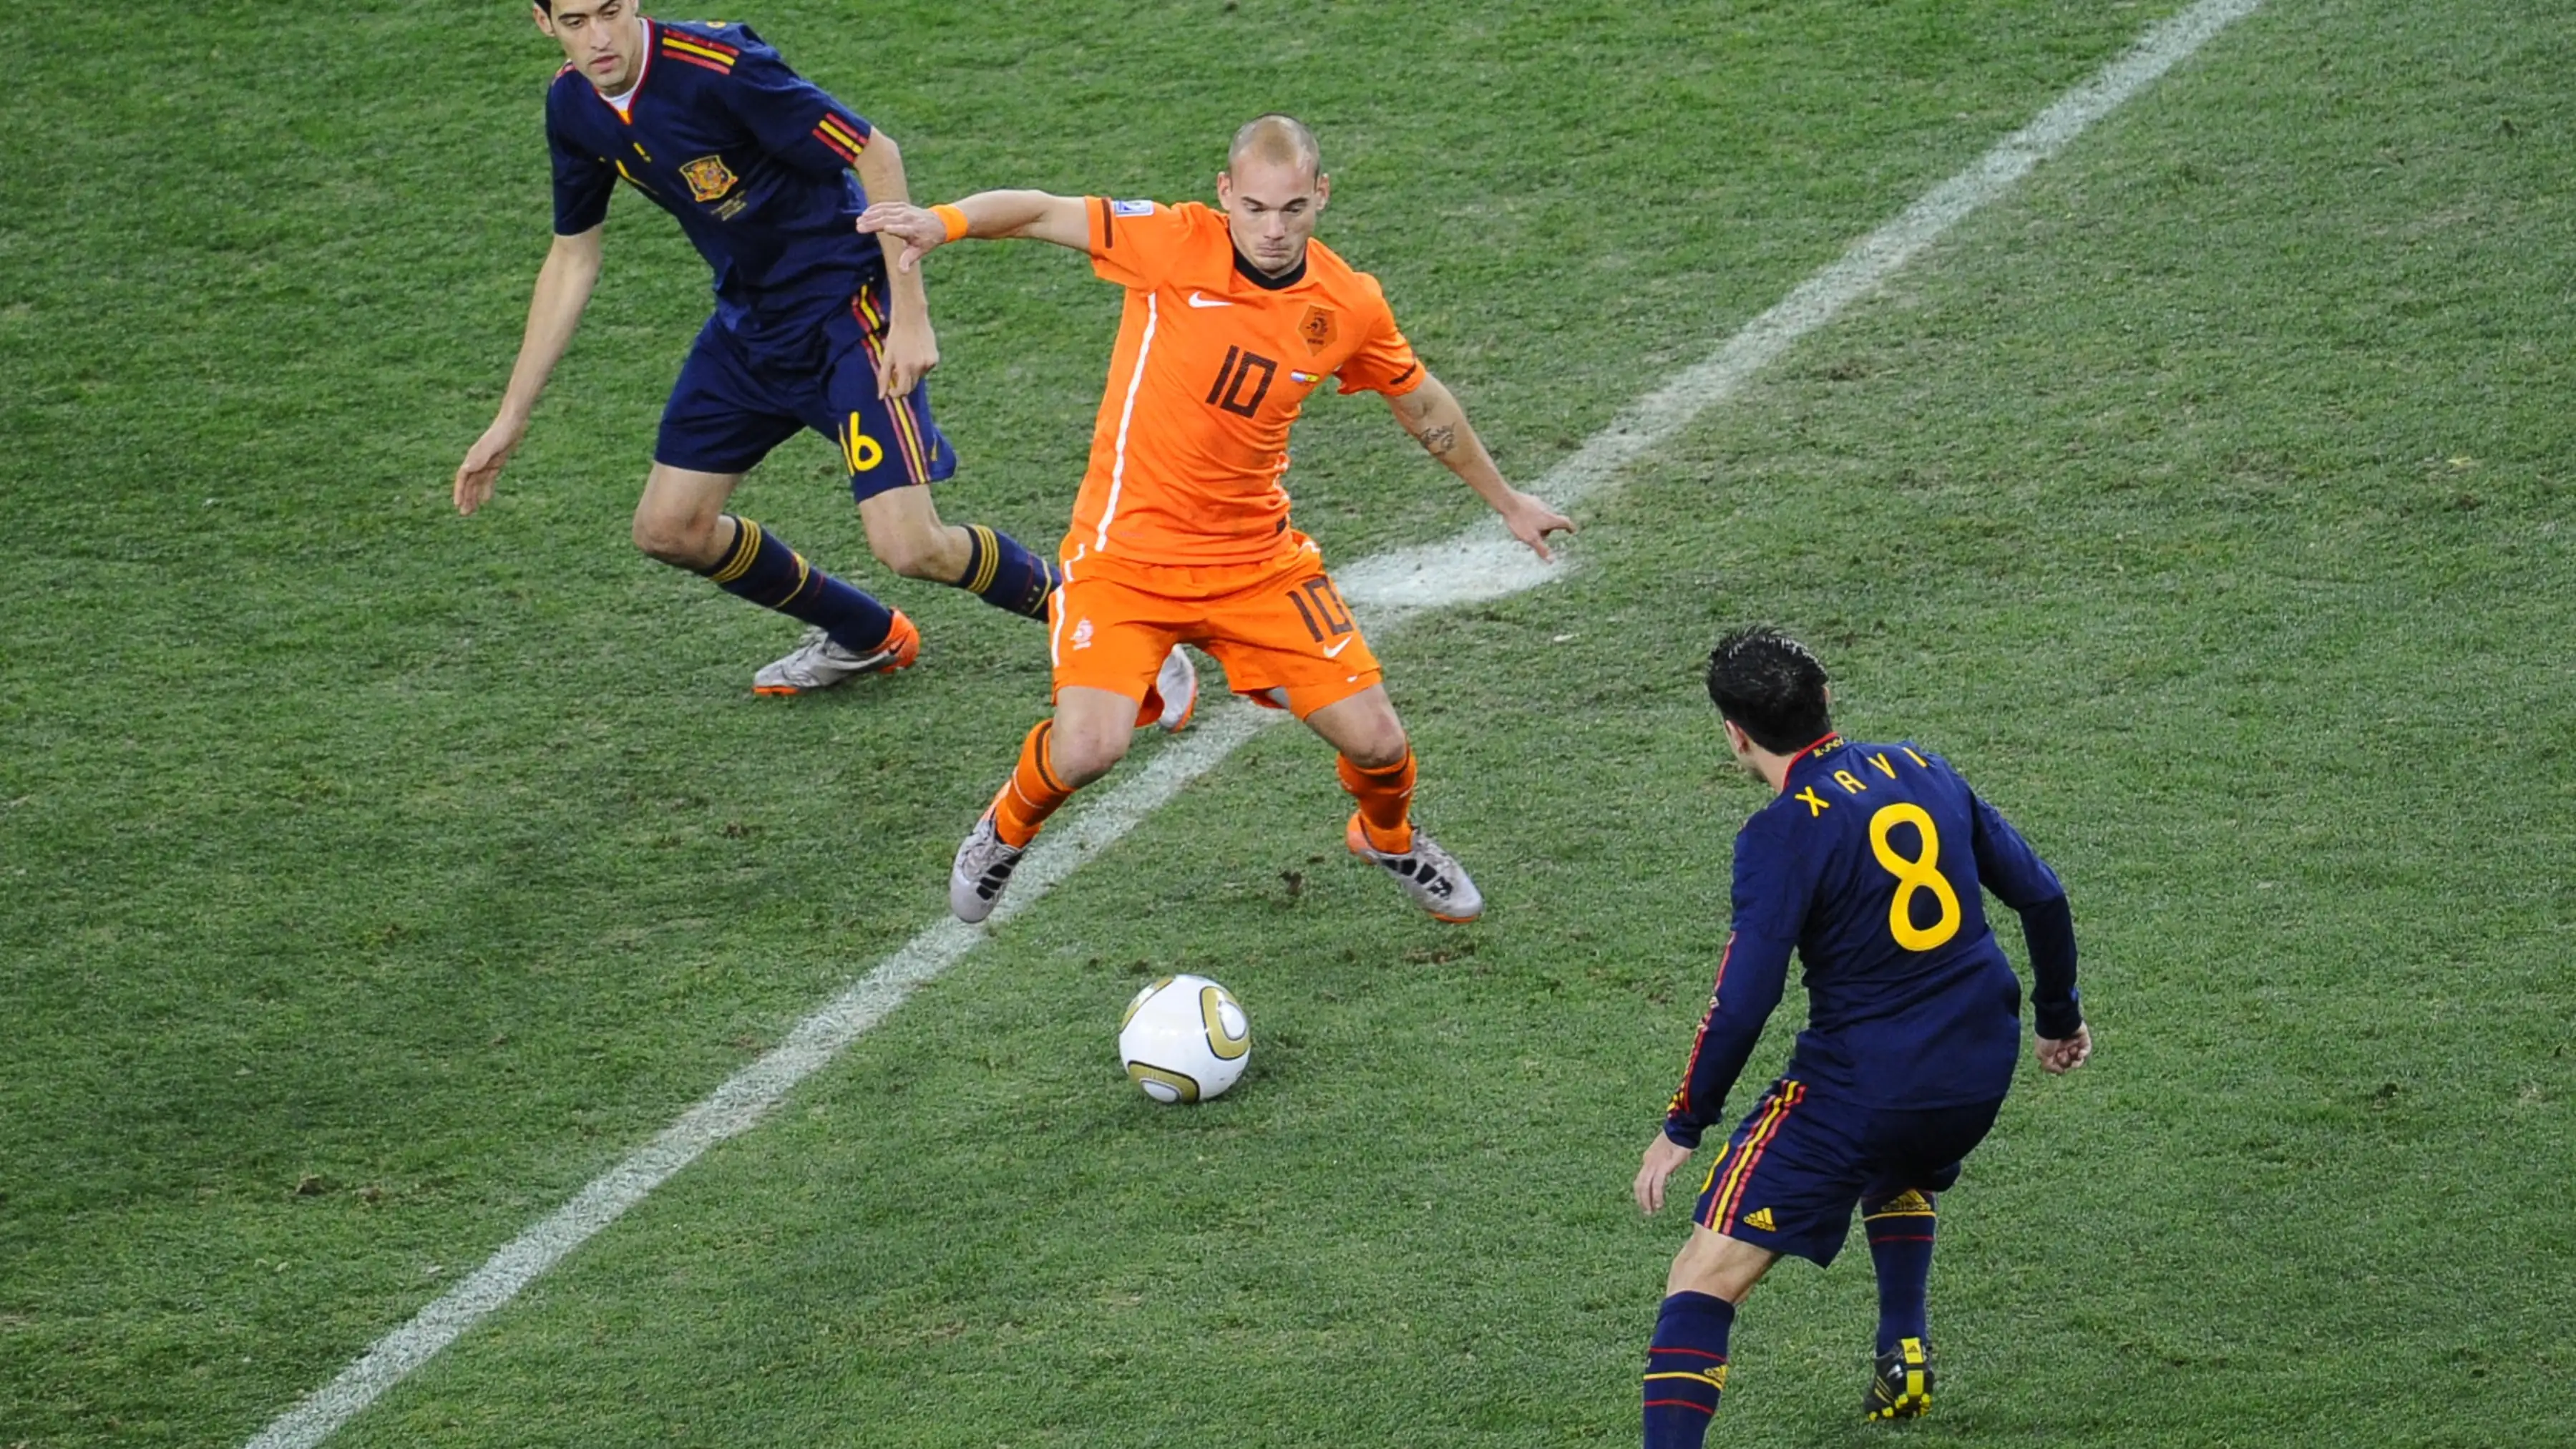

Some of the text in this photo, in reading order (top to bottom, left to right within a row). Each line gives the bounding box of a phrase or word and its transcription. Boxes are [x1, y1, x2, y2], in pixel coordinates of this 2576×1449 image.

[1205, 345, 1278, 419] 10
[1285, 575, 1355, 643] 10
[1794, 746, 1928, 817] XAVI
[1869, 802, 1961, 952] 8
